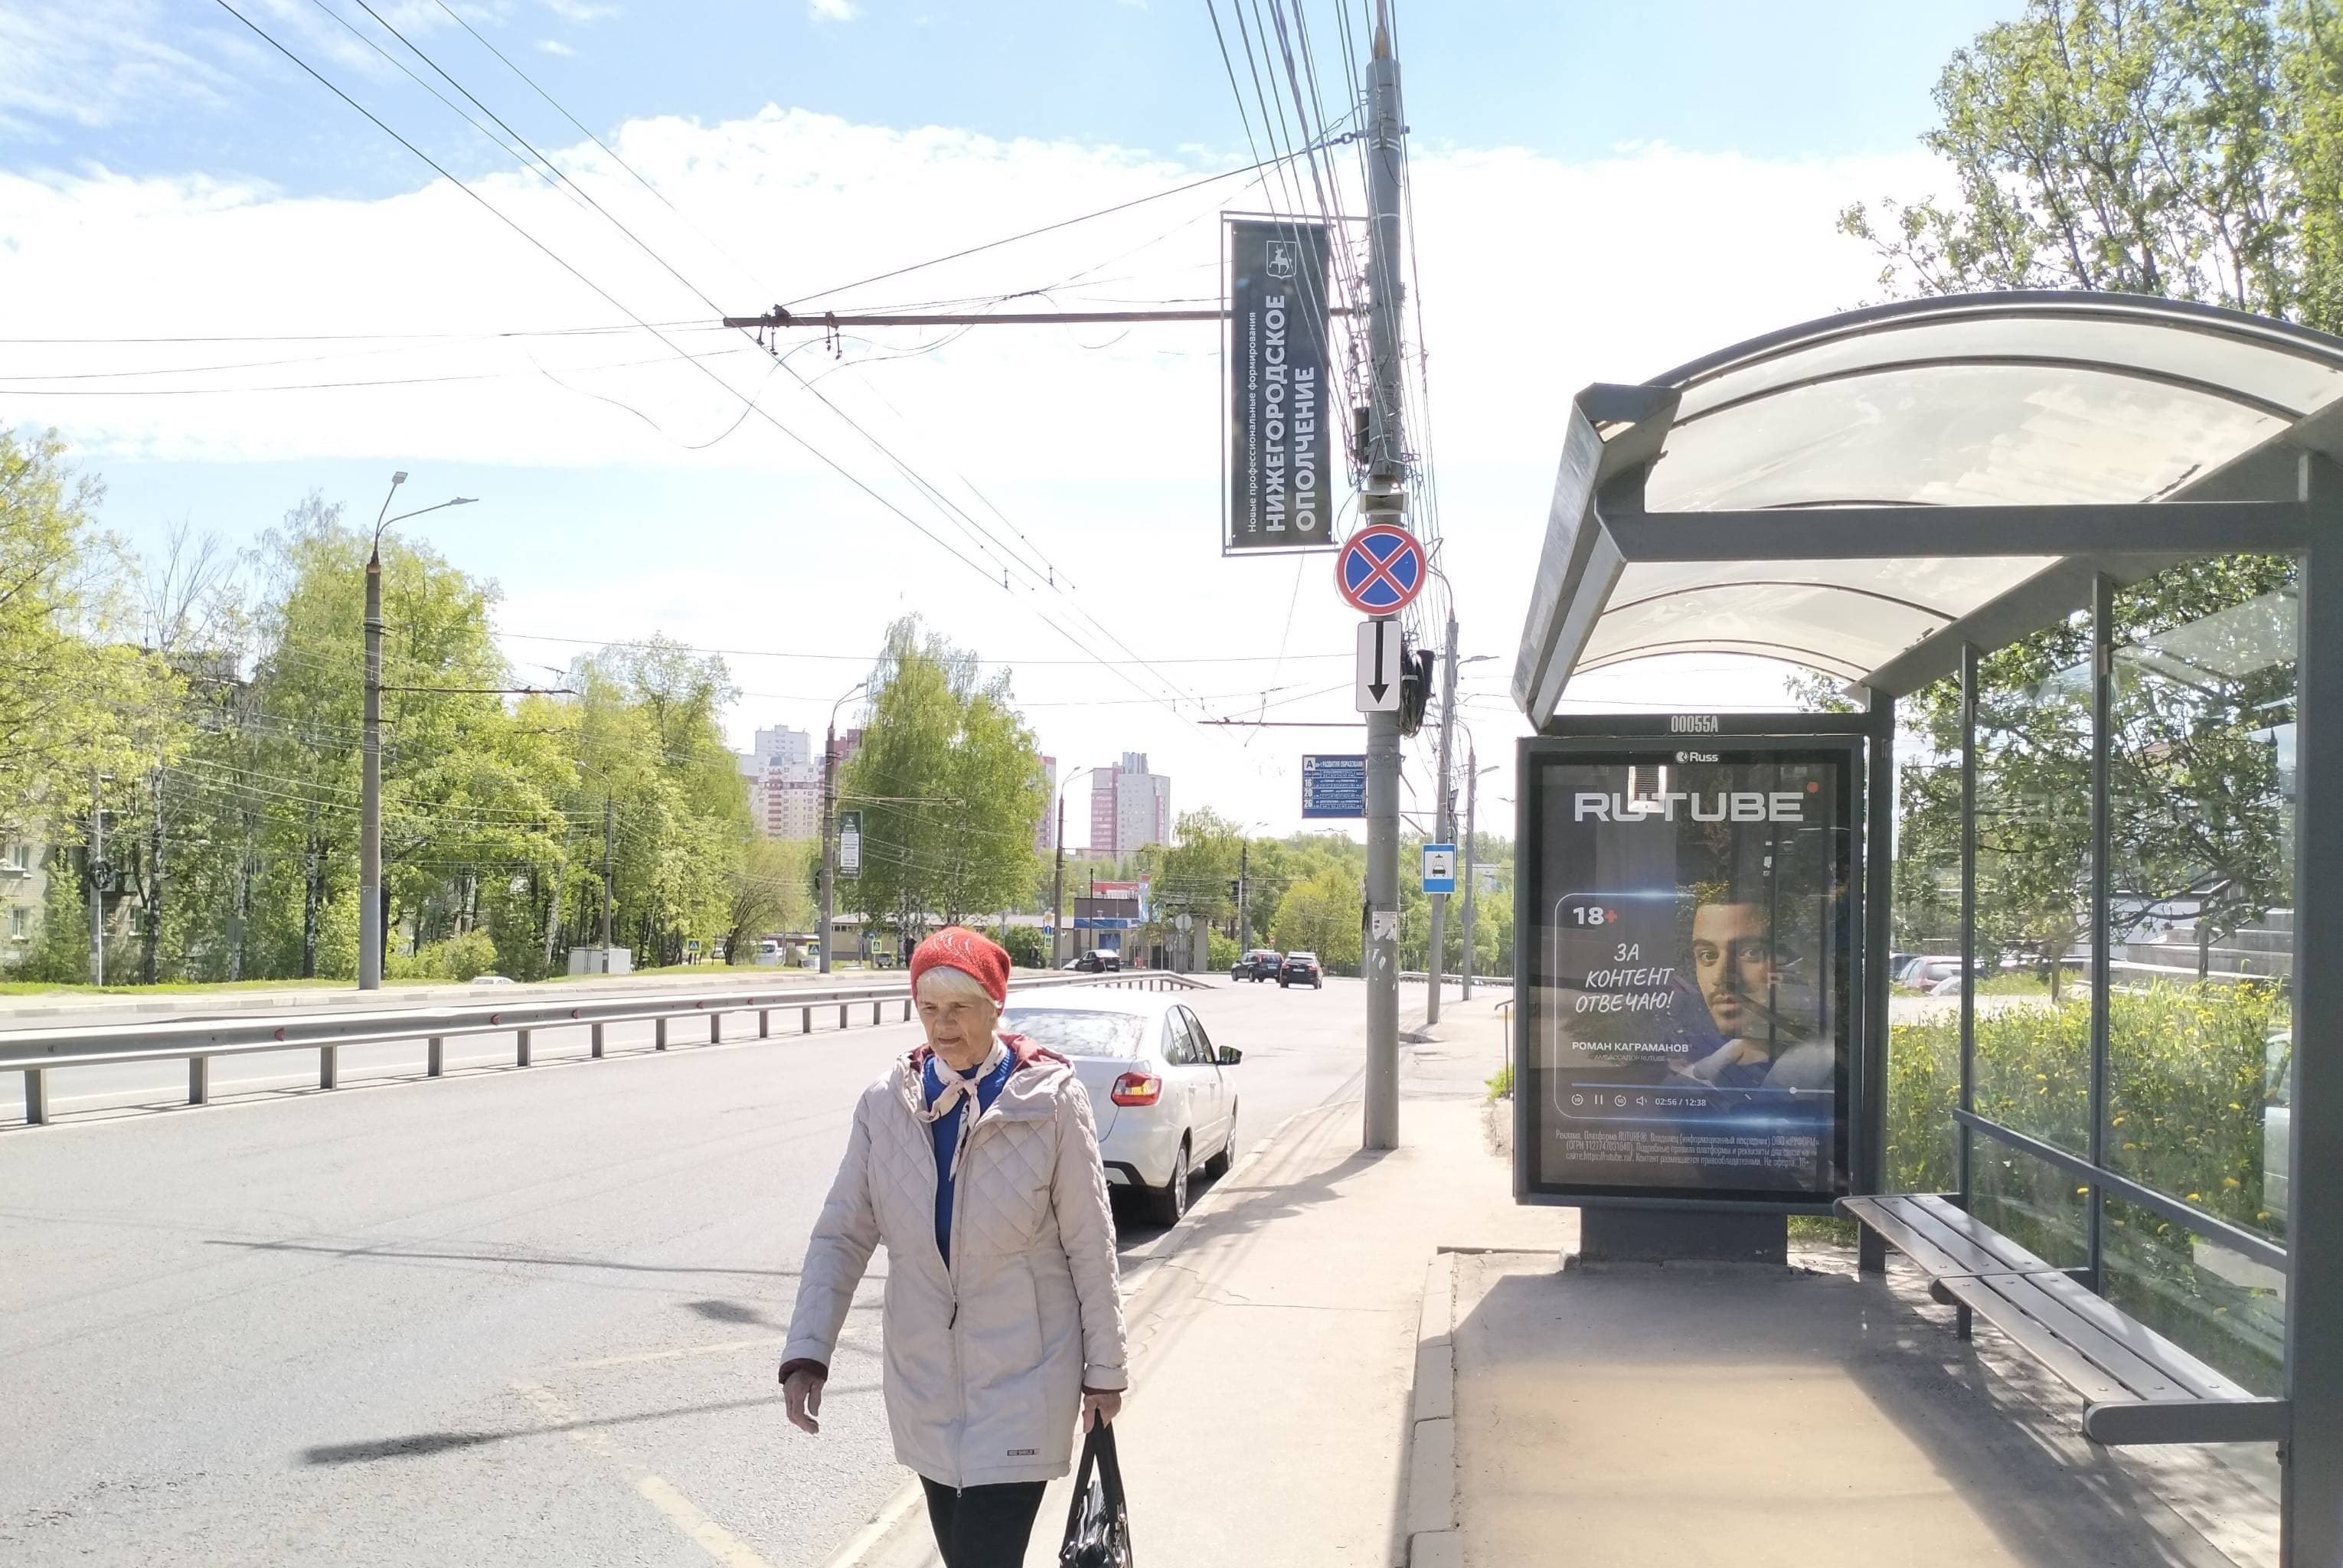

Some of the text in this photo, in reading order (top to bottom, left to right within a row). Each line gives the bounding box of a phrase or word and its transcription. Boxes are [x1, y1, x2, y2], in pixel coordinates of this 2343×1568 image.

[1247, 312, 1258, 532] Новые профессиональные формирования
[1266, 296, 1287, 531] НИЖЕГОРОДСКОЕ
[1296, 368, 1315, 531] ОПОЛЧЕНИЕ
[1670, 715, 1719, 733] 00055A
[1689, 752, 1719, 763] Russ
[1574, 792, 1804, 822] RUTUBE
[1573, 906, 1617, 925] 18+
[1614, 942, 1639, 962] ЗА
[1585, 967, 1675, 988] КОНТЕНТ
[1575, 991, 1675, 1013] ОТВЕЧАЮ!
[1572, 1041, 1689, 1053] РОМАН КАГРАМАНОВ
[1655, 1097, 1677, 1106] 02:56
